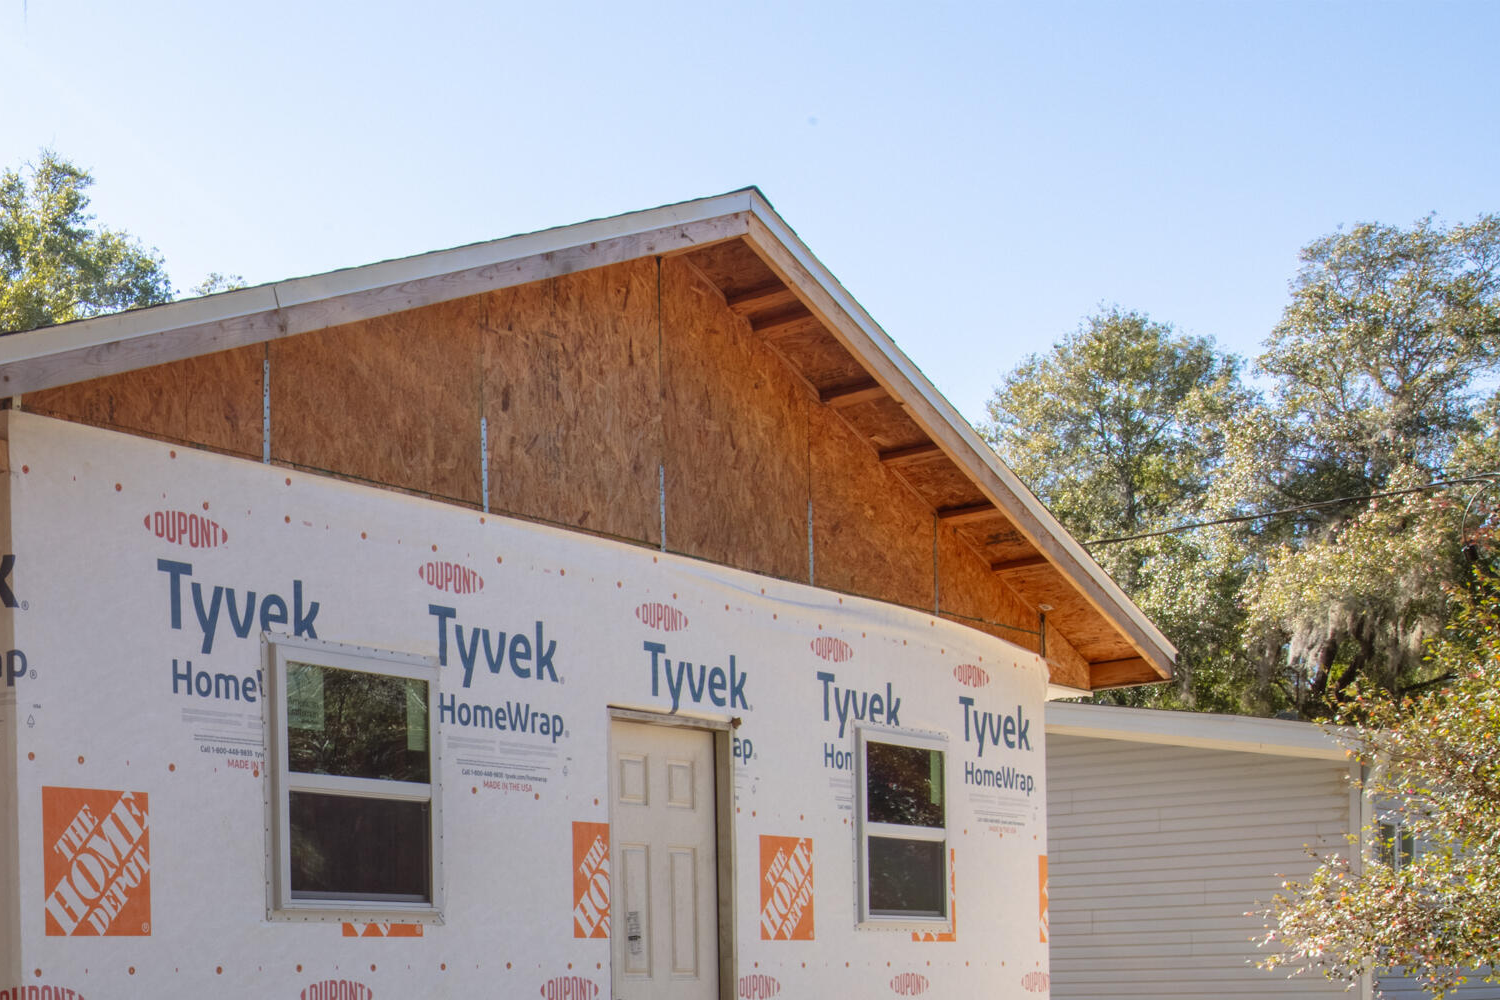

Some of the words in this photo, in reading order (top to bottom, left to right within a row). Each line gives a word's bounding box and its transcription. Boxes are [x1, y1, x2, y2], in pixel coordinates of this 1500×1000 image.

[155, 510, 219, 548] DUPONT
[426, 562, 477, 594] DUPONT
[157, 558, 320, 654] Tyvek
[642, 603, 683, 632] DUPONT
[428, 604, 559, 688] Tyvek
[815, 637, 849, 663] DUPONT
[643, 641, 749, 714] Tyvek
[957, 664, 986, 688] DUPONT
[439, 692, 564, 743] HomeWrap
[817, 671, 901, 739] Tyvek
[959, 696, 1031, 758] Tyvek
[200, 744, 210, 753] Call
[228, 759, 249, 769] MADE
[964, 761, 1034, 796] HomeWrap
[53, 803, 99, 862] THE
[45, 791, 149, 936] HOME
[578, 834, 608, 880] THE
[765, 846, 788, 887] THE
[87, 845, 150, 936] DEPOT
[761, 838, 814, 940] HOME
[781, 877, 814, 940] DEPOT
[739, 974, 776, 1000] DUPONT
[895, 973, 925, 996] DUPONT
